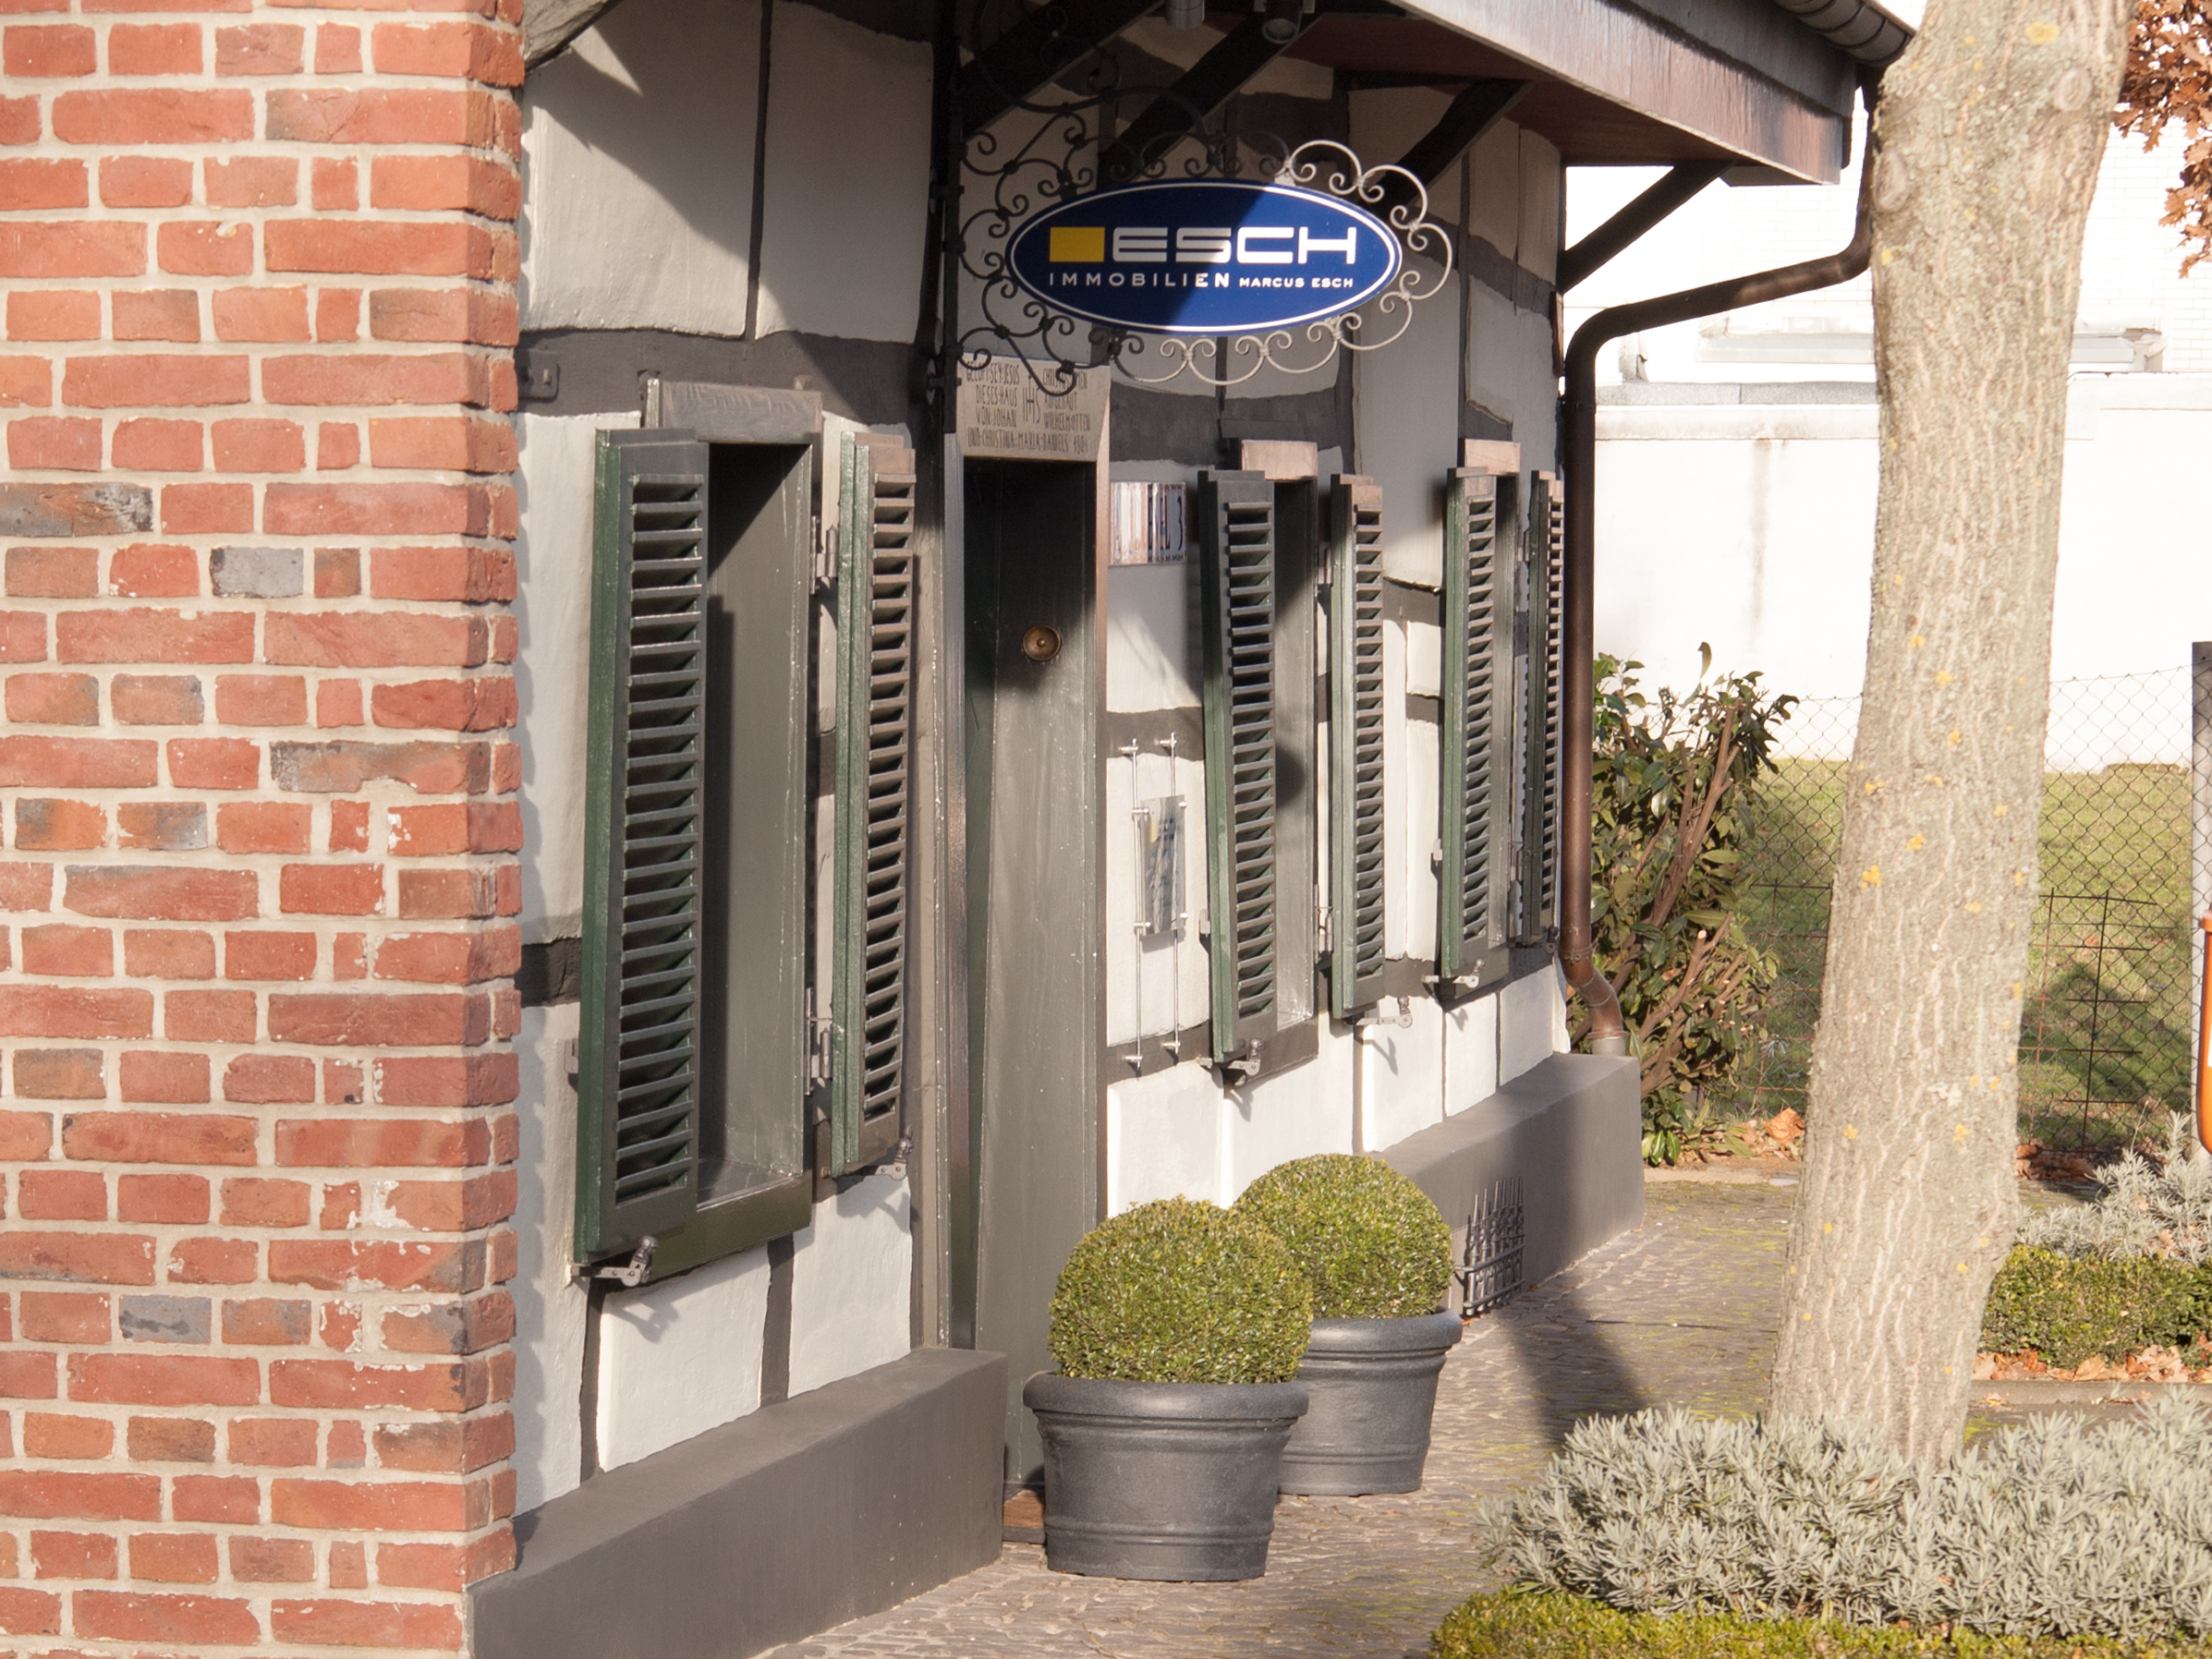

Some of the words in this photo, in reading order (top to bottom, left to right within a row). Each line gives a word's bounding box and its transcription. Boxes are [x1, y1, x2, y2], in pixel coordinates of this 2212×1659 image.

[1112, 226, 1357, 264] ESCH
[1049, 272, 1230, 287] IMMOBILIEN
[1239, 277, 1295, 287] MARCUS
[1311, 277, 1354, 287] ESCH
